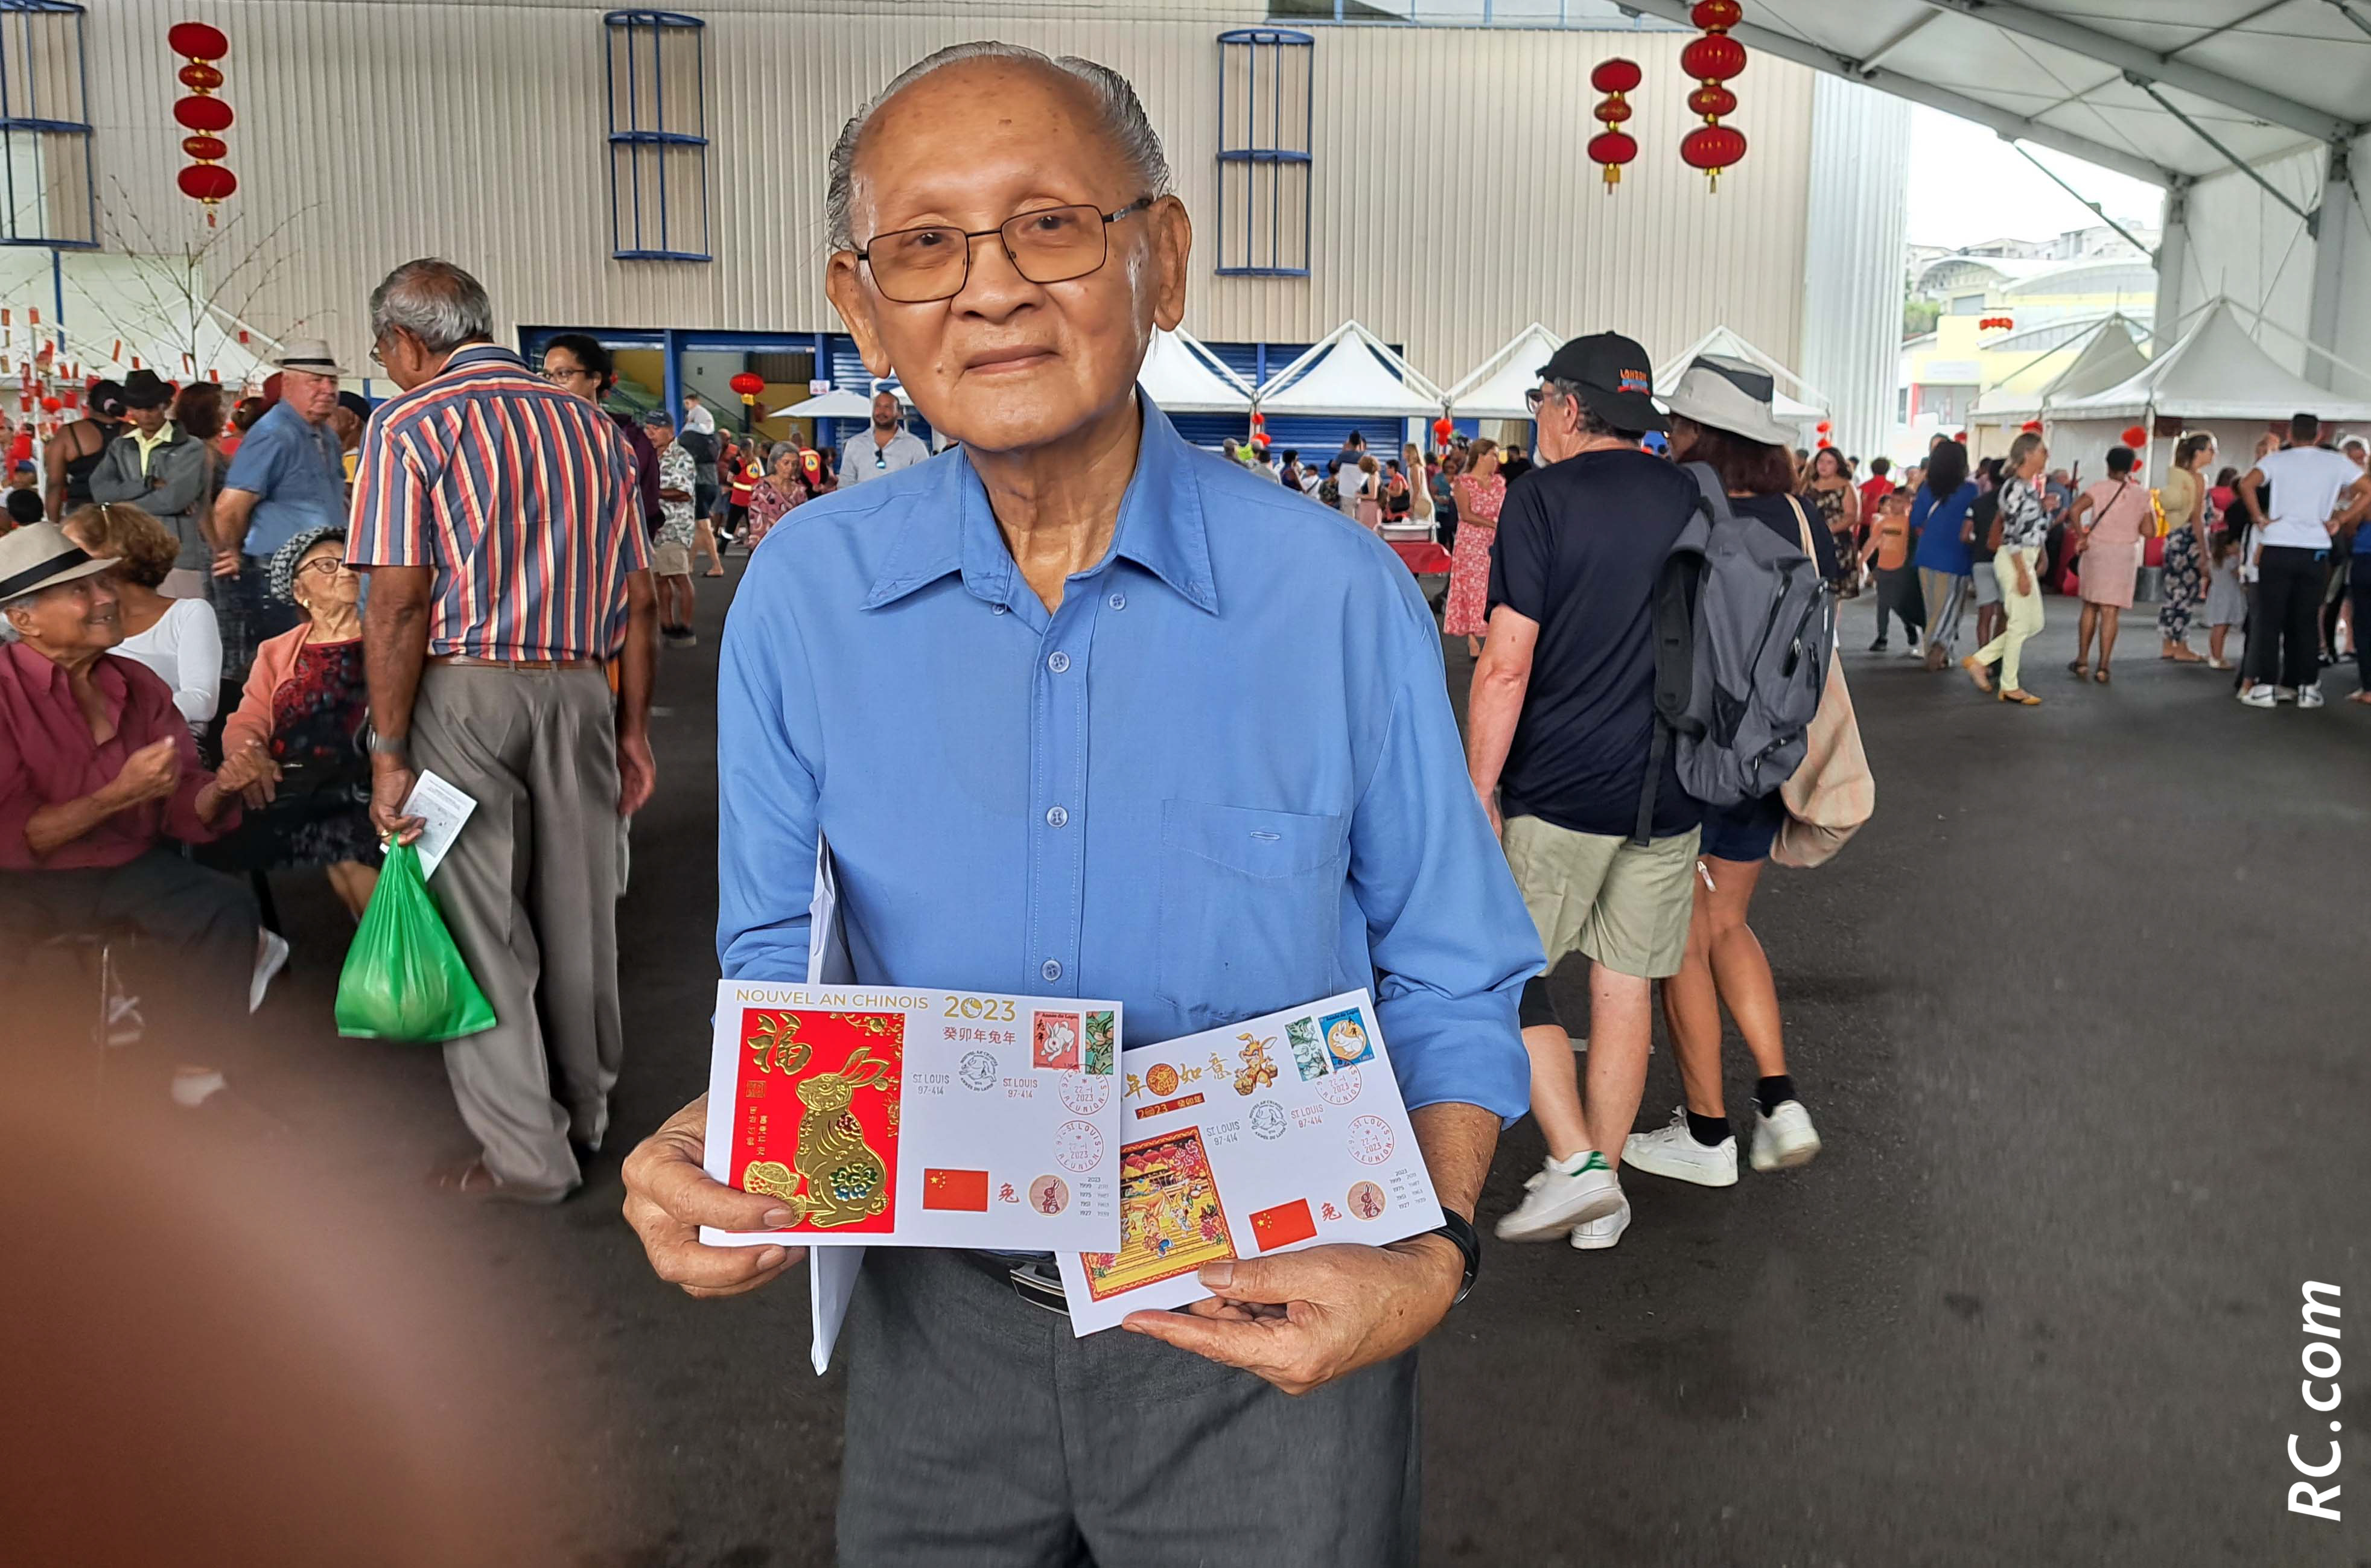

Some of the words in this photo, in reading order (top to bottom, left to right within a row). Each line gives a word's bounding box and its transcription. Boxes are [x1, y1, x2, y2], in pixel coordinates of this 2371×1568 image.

[736, 989, 814, 1004] NOUVEL
[820, 994, 846, 1006] AN
[852, 994, 928, 1009] CHINOIS
[944, 995, 1016, 1022] 2023
[925, 1074, 950, 1085] LOUIS
[1014, 1078, 1038, 1088] LOUIS
[918, 1085, 944, 1096] 97-414
[1332, 1082, 1350, 1094] 2023
[1301, 1104, 1323, 1117] LOUIS
[1217, 1121, 1240, 1134] LOUIS
[1364, 1142, 1382, 1154] 2023
[1395, 1168, 1408, 1176] 2023
